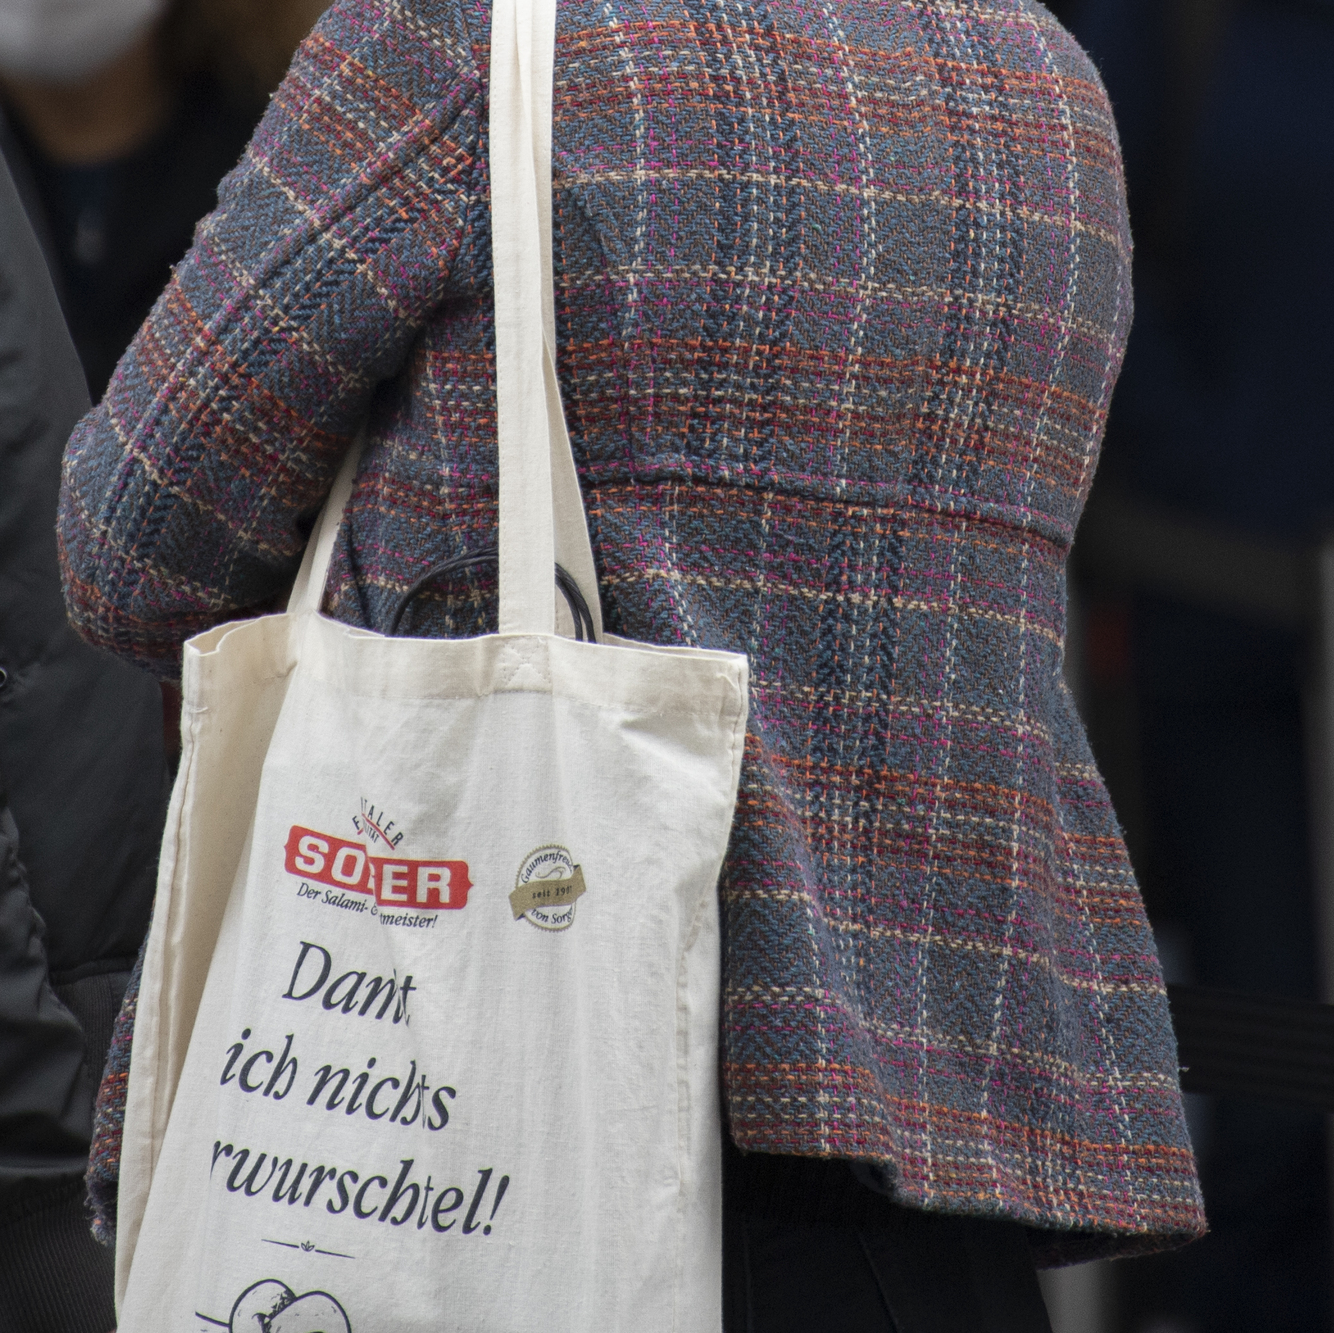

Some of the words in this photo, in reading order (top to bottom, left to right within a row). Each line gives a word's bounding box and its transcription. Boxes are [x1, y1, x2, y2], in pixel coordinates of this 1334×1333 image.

[296, 882, 321, 900] Der
[321, 890, 369, 913] Salami-
[532, 889, 551, 900] seit
[530, 909, 549, 923] von
[220, 1028, 298, 1100] ich
[306, 1057, 457, 1131] nichts
